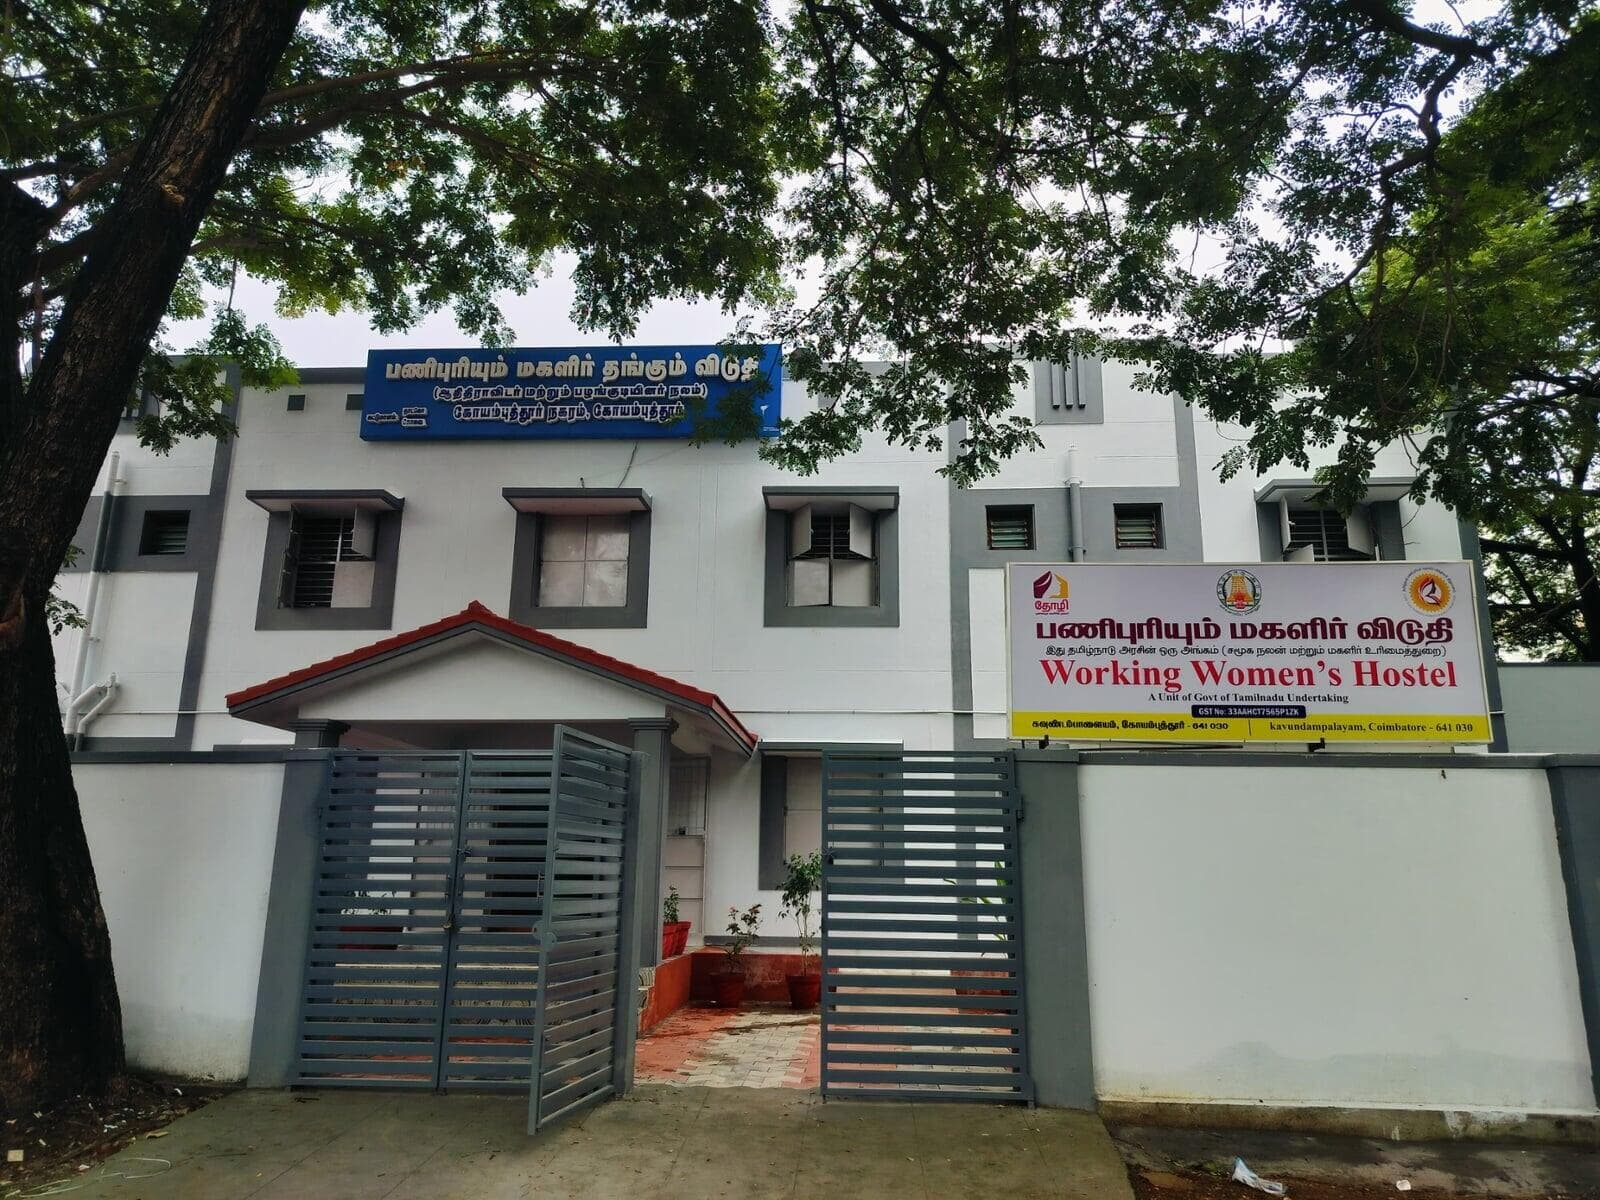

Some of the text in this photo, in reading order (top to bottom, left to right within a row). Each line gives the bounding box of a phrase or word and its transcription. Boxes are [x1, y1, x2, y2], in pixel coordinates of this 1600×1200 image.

[386, 355, 508, 383] பணிபுரியும்
[516, 354, 594, 379] மகளிர்
[603, 353, 687, 383] தங்கும்
[524, 385, 572, 401] மற்றும்
[453, 403, 544, 423] கோயம்புத்தூர்
[1035, 599, 1069, 612] தோழி
[1036, 617, 1453, 646] பணிபுரியும் மகளிர் விடுதி
[1046, 645, 1065, 656] இது
[1068, 645, 1116, 656] தமிழ்நாடு
[1119, 645, 1156, 656] அரசின்
[1159, 647, 1178, 657] ஒரு
[1181, 645, 1219, 656] அங்கம்
[1256, 645, 1286, 657] நலன்
[1289, 645, 1325, 657] மற்றும்
[1327, 645, 1362, 655] மகளிர்
[1039, 659, 1182, 693] Working
[1353, 660, 1458, 688] Hostel
[1148, 693, 1349, 703] A Unit of Govt of Tamilnadu Undertaking
[1192, 722, 1211, 730] 641
[1213, 722, 1229, 730] 030
[1270, 722, 1366, 734] kavundampalayam,
[1369, 722, 1427, 732] Coimbatore
[1436, 723, 1453, 732] 641
[1456, 723, 1473, 732] 030
